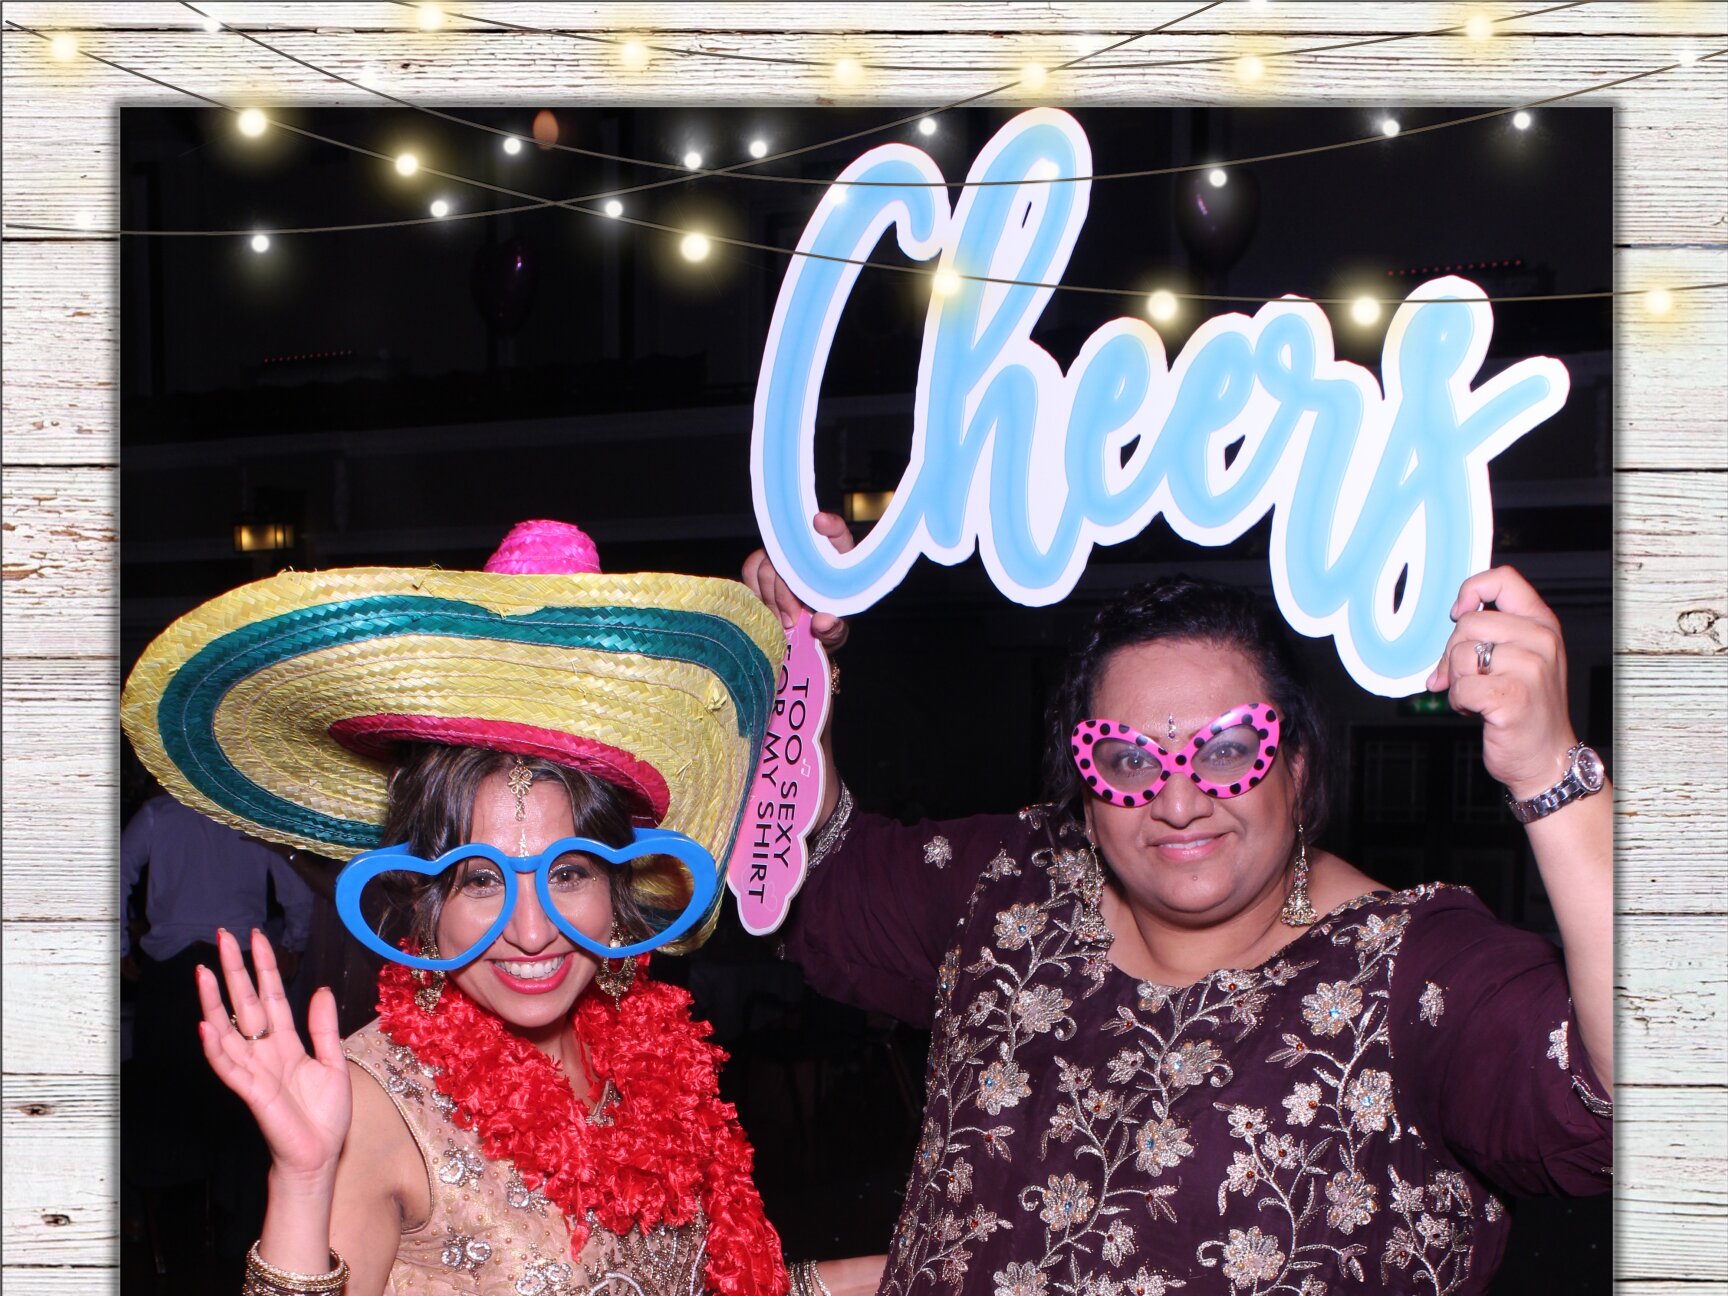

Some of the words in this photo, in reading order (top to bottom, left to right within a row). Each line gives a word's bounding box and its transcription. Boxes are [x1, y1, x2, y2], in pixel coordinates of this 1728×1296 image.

[757, 116, 1560, 688] Cheers
[761, 731, 782, 787] MY
[785, 677, 809, 766] TOO
[748, 801, 774, 904] SHIRT
[773, 780, 798, 868] SEXY
